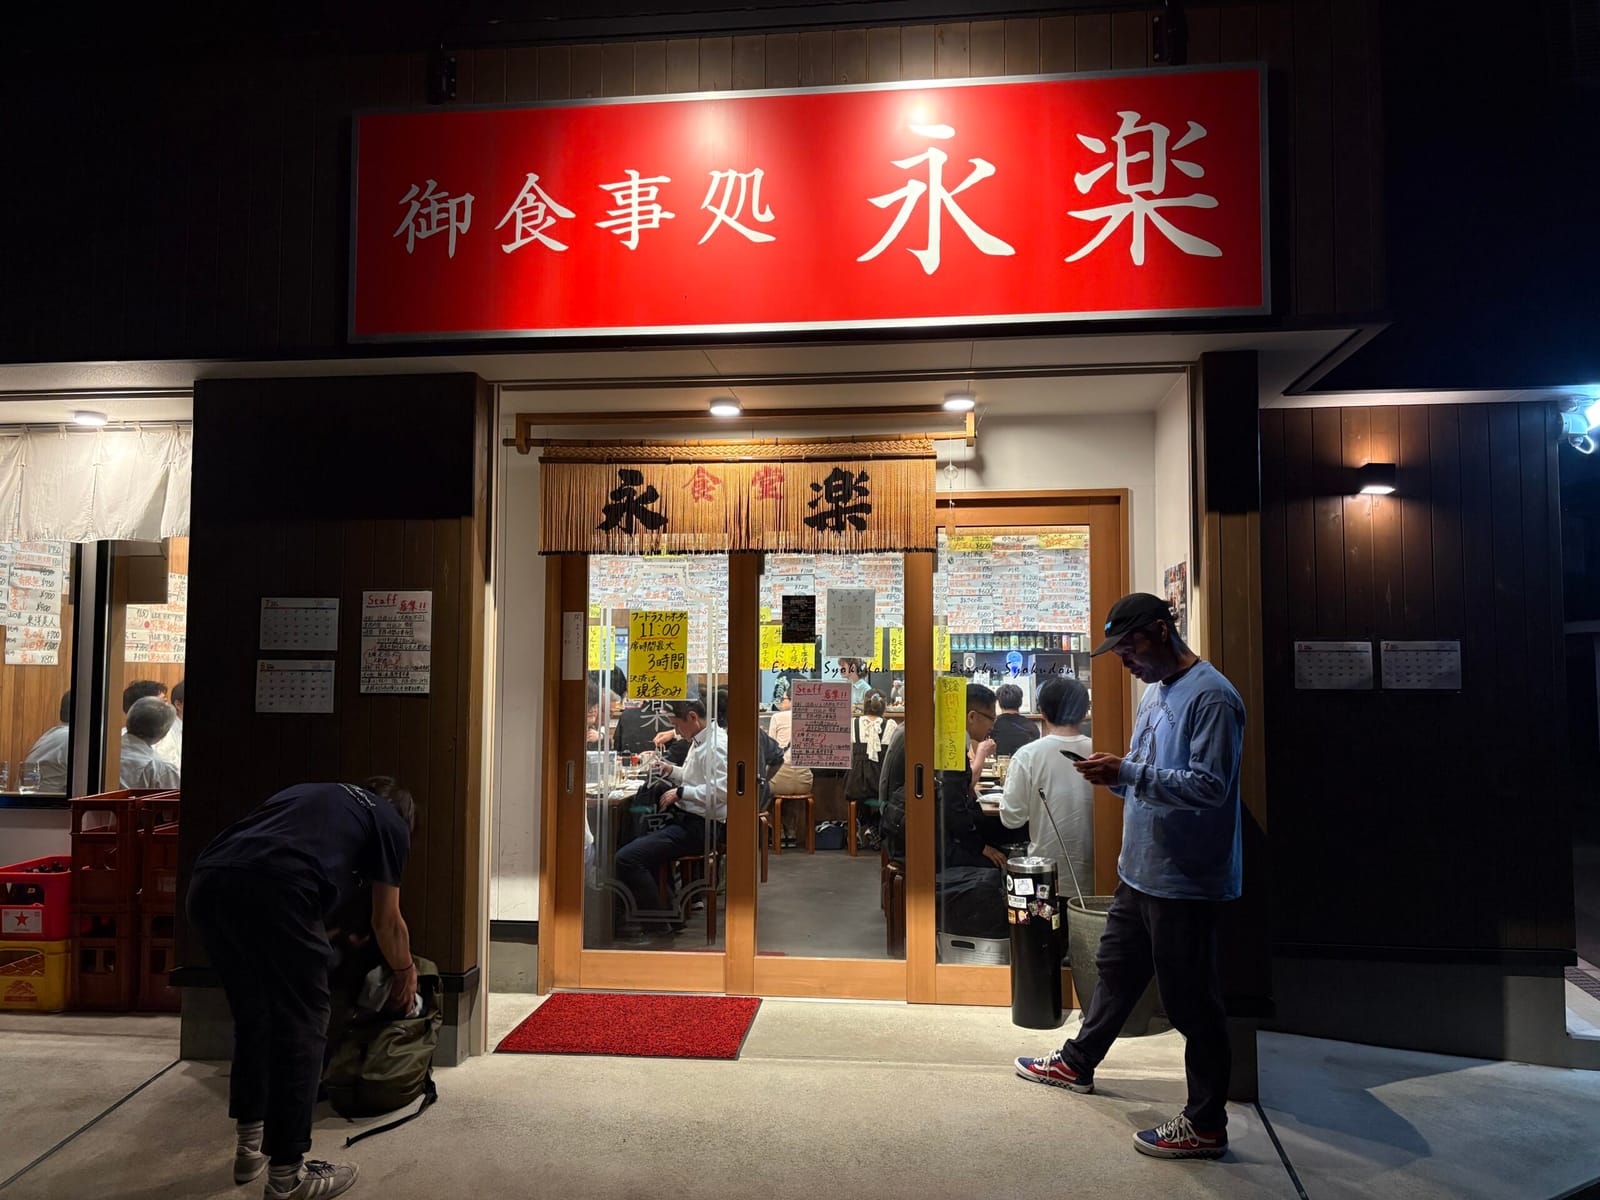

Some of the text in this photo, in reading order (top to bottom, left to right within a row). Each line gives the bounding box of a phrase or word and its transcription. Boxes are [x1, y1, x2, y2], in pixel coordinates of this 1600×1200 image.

[393, 109, 1223, 276] 御食事処 永楽
[595, 468, 669, 536] 永
[803, 467, 872, 532] 楽
[367, 593, 398, 605] Staff
[25, 615, 56, 627] 東洋美人
[640, 622, 681, 638] 11:00
[630, 640, 676, 652] 席時間最大
[647, 652, 685, 671] 3時間
[771, 660, 817, 674] Eiraku
[950, 661, 1075, 679] Eiraku Syokudou
[636, 682, 682, 698] 現金のみ
[795, 683, 823, 695] Staff
